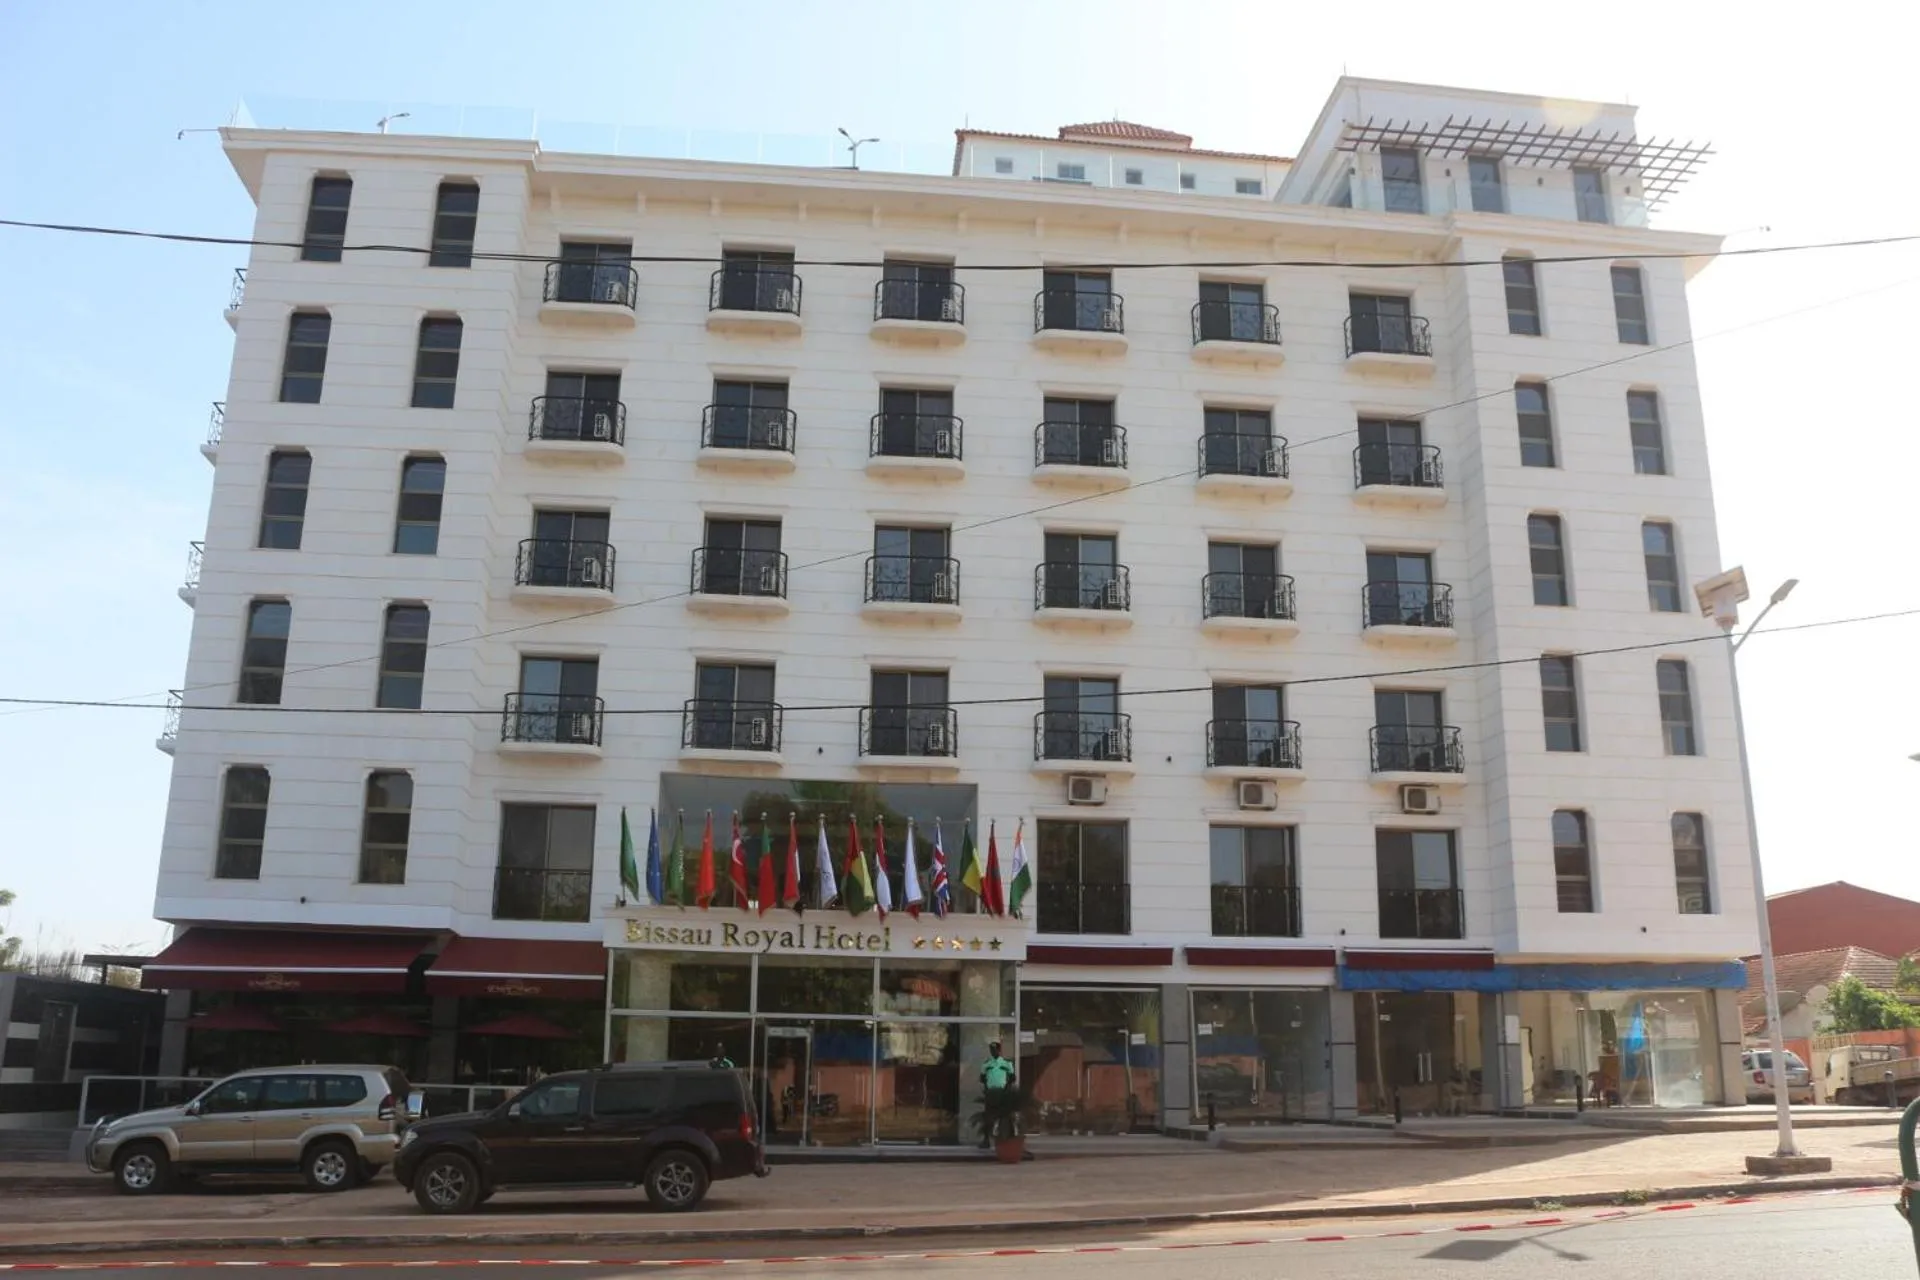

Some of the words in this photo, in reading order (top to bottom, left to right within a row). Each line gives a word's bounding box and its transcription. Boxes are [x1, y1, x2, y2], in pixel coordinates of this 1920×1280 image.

[625, 918, 712, 945] Bissau
[721, 922, 805, 953] Royal
[814, 925, 891, 952] Hotel
